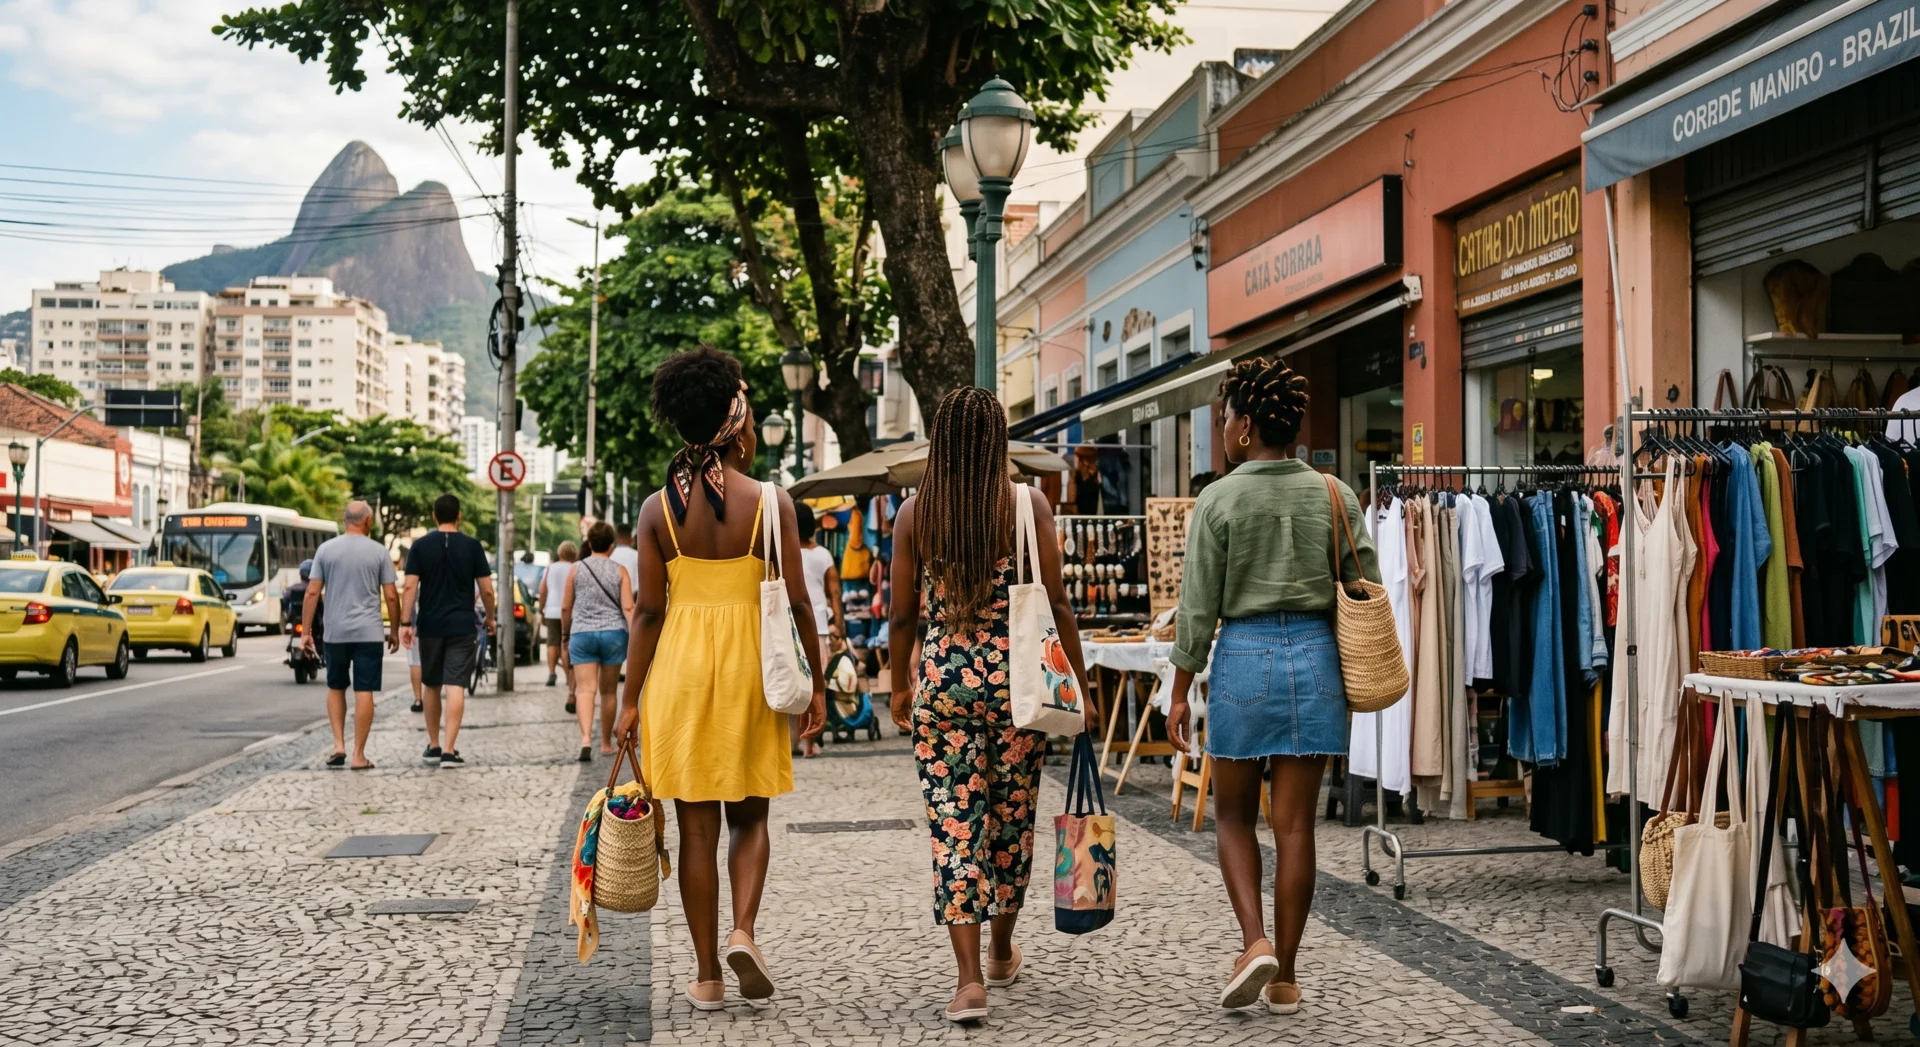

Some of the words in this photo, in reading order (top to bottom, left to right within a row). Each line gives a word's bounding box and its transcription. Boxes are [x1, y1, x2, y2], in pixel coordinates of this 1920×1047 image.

[1749, 51, 1823, 111] MANIRO
[1842, 6, 1920, 69] BRAZIL
[1244, 260, 1271, 297] CATA
[1273, 233, 1323, 284] SORRAA
[1506, 209, 1526, 259] DO
